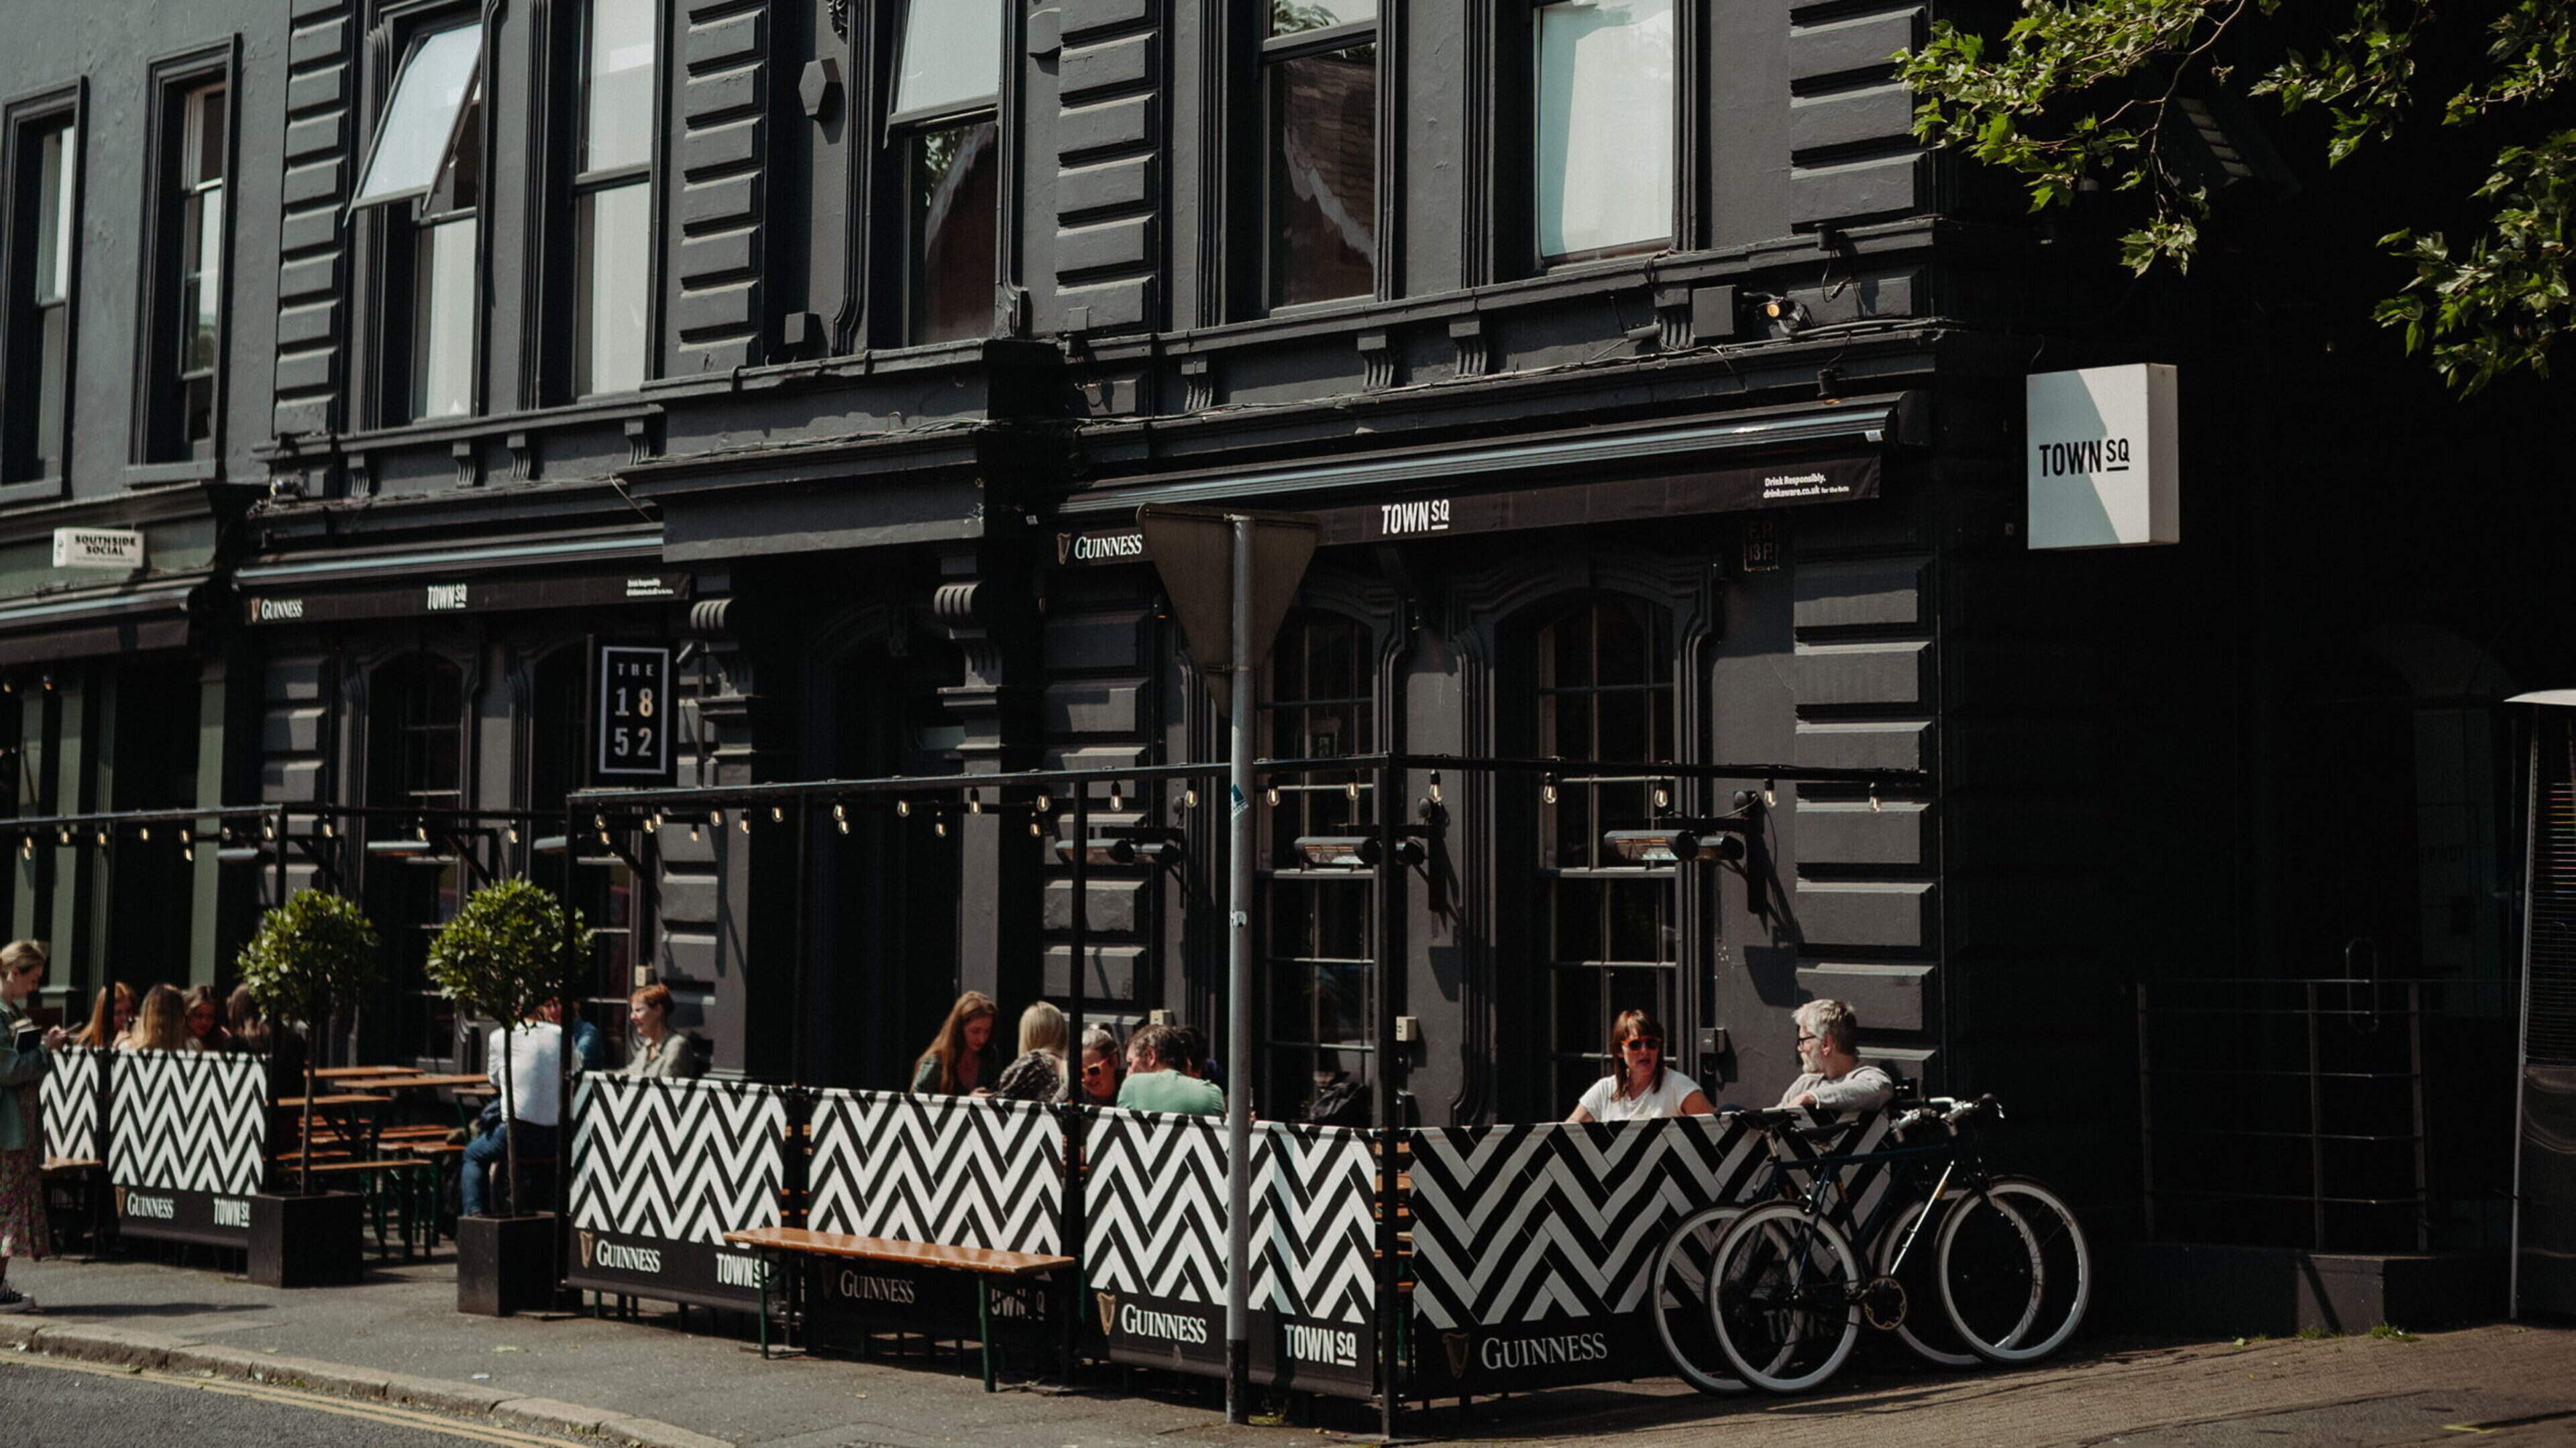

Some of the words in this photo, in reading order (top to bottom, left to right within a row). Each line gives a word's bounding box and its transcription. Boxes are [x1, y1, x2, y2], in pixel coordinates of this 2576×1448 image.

[74, 535, 136, 547] SOUTHSIDE
[86, 545, 124, 556] SOCIAL
[1075, 535, 1143, 559] GUINNESS
[617, 663, 654, 677] THE
[127, 1191, 174, 1219] GUINNESS
[596, 1238, 661, 1274] GUINNESS
[841, 1269, 915, 1304] GUINNESS
[1120, 1302, 1208, 1345] GUINNESS
[1481, 1332, 1607, 1370] GUINNESS
